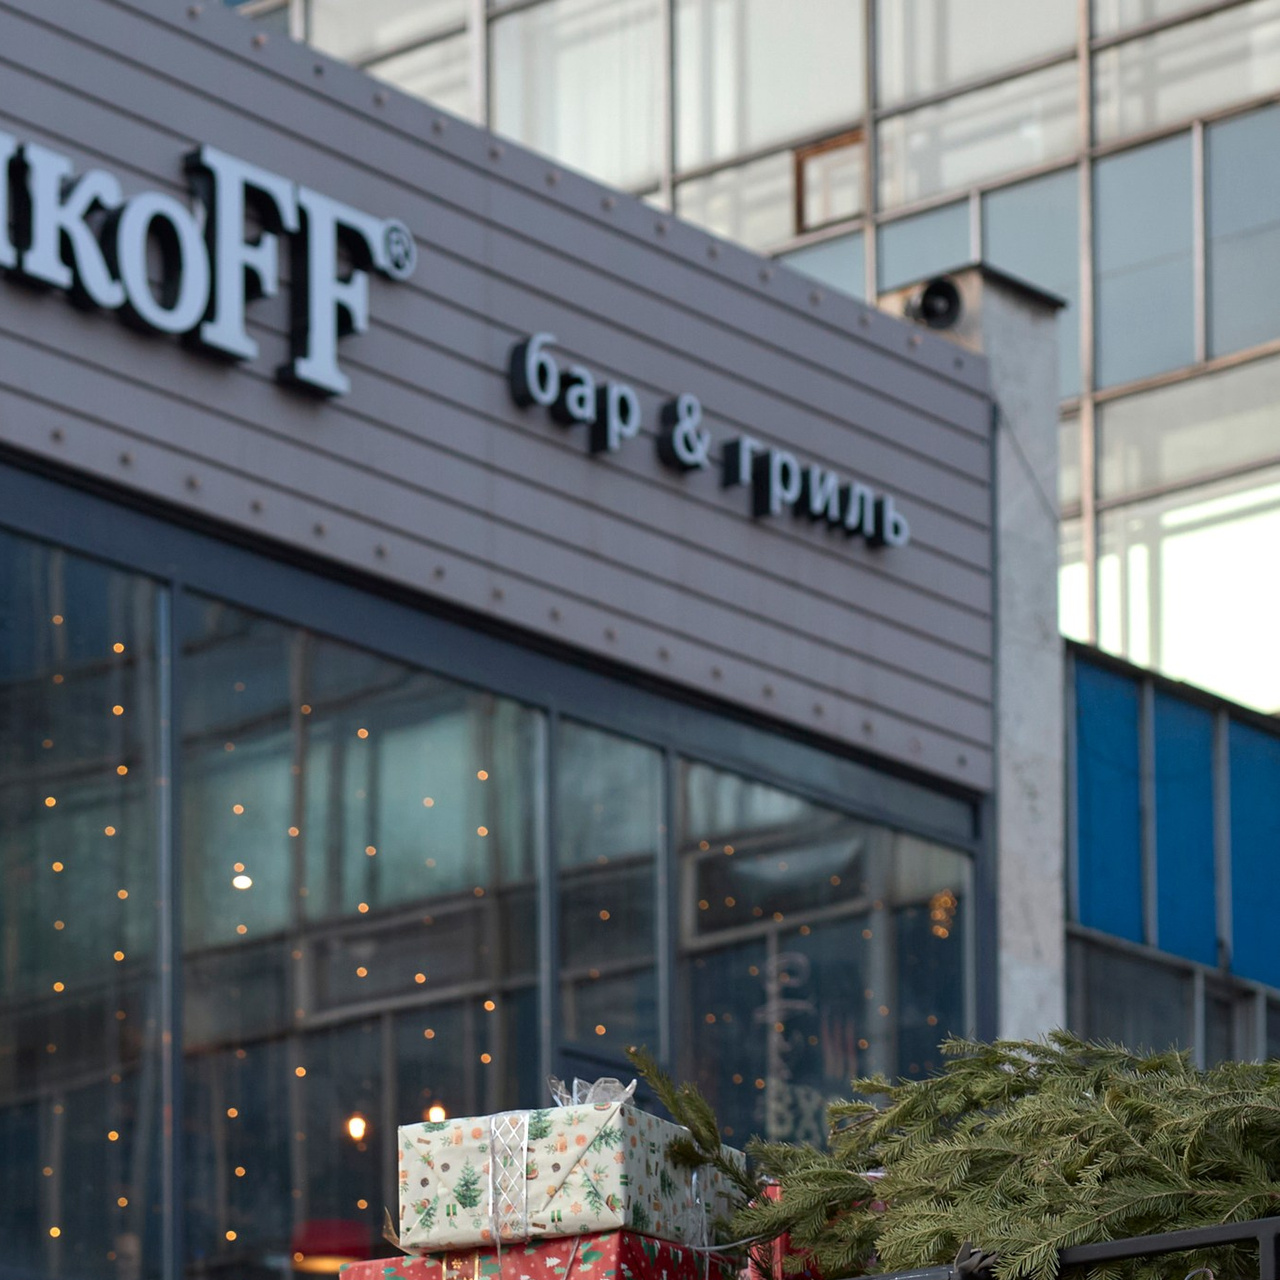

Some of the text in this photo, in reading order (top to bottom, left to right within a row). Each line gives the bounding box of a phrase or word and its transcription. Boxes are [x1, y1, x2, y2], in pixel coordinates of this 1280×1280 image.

[524, 332, 910, 547] бар & гриль
